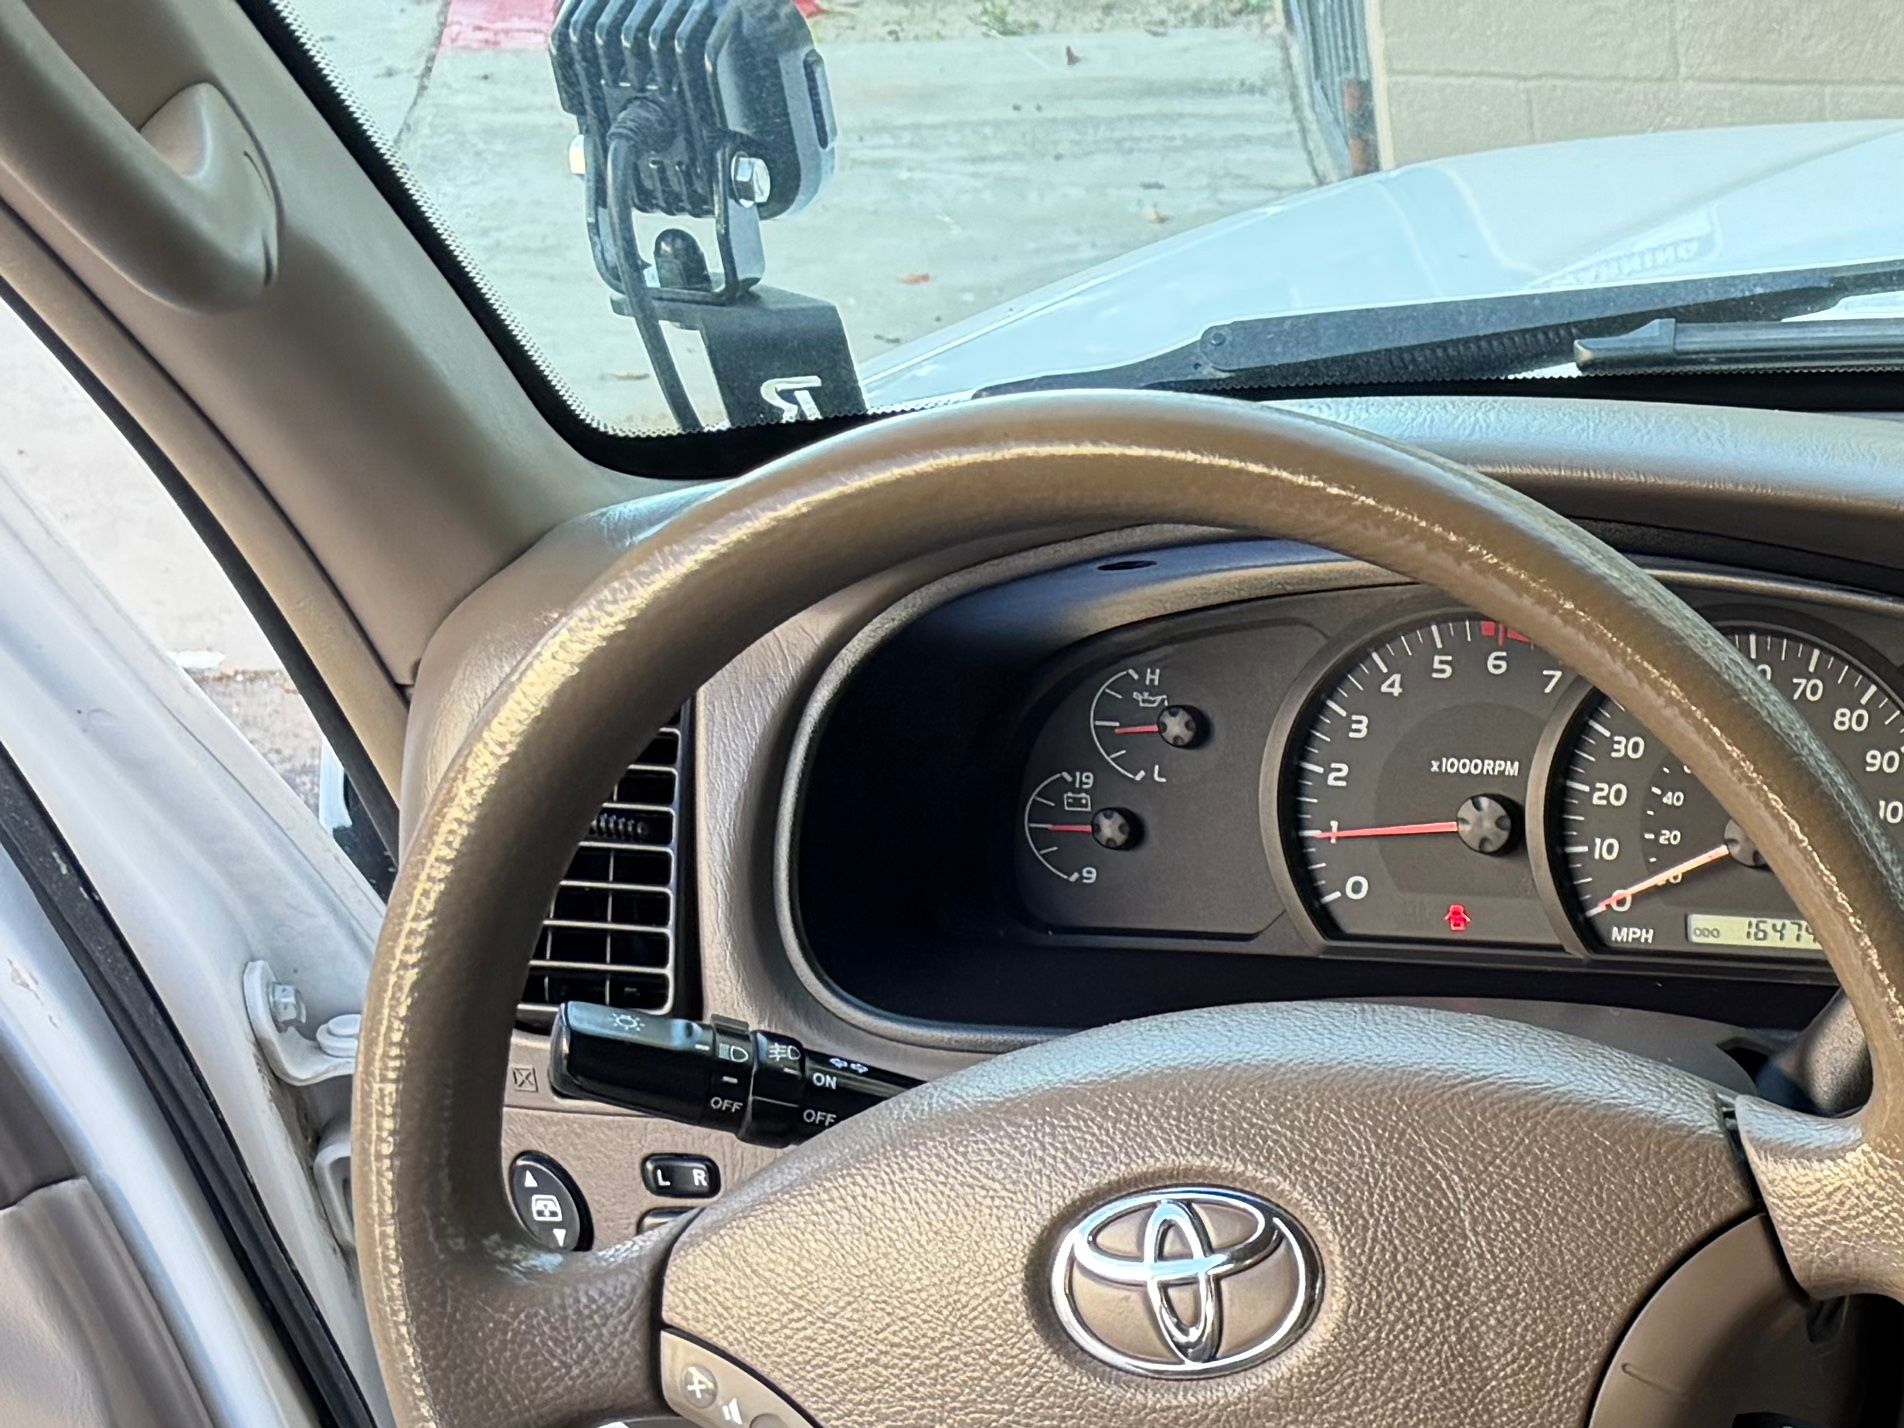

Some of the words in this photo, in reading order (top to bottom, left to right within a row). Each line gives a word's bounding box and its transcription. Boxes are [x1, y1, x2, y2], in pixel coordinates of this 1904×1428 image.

[1432, 655, 1453, 678] 5
[1487, 651, 1507, 674] 6
[1145, 668, 1160, 686] H
[1380, 674, 1402, 696] 4
[1542, 670, 1562, 693] 7
[1792, 679, 1823, 702] 70
[1348, 715, 1369, 738] 3
[1833, 708, 1869, 732] 80
[1610, 736, 1645, 759] 30
[1153, 764, 1167, 782] L
[1430, 757, 1520, 777] x1000RPM
[1865, 750, 1900, 774] 90
[1074, 771, 1094, 789] 19
[1327, 763, 1349, 786] 2
[1592, 782, 1627, 807] 20
[1662, 791, 1684, 807] 40
[1659, 830, 1681, 845] 20
[1594, 838, 1619, 861] 10
[1082, 866, 1097, 884] 9
[1345, 875, 1369, 899] 0
[1611, 889, 1632, 911] 0
[1611, 927, 1654, 944] MPH
[811, 1072, 838, 1090] ON
[710, 1096, 743, 1114] OFF
[803, 1108, 838, 1127] OFF
[656, 1168, 671, 1187] L
[692, 1169, 709, 1188] R
